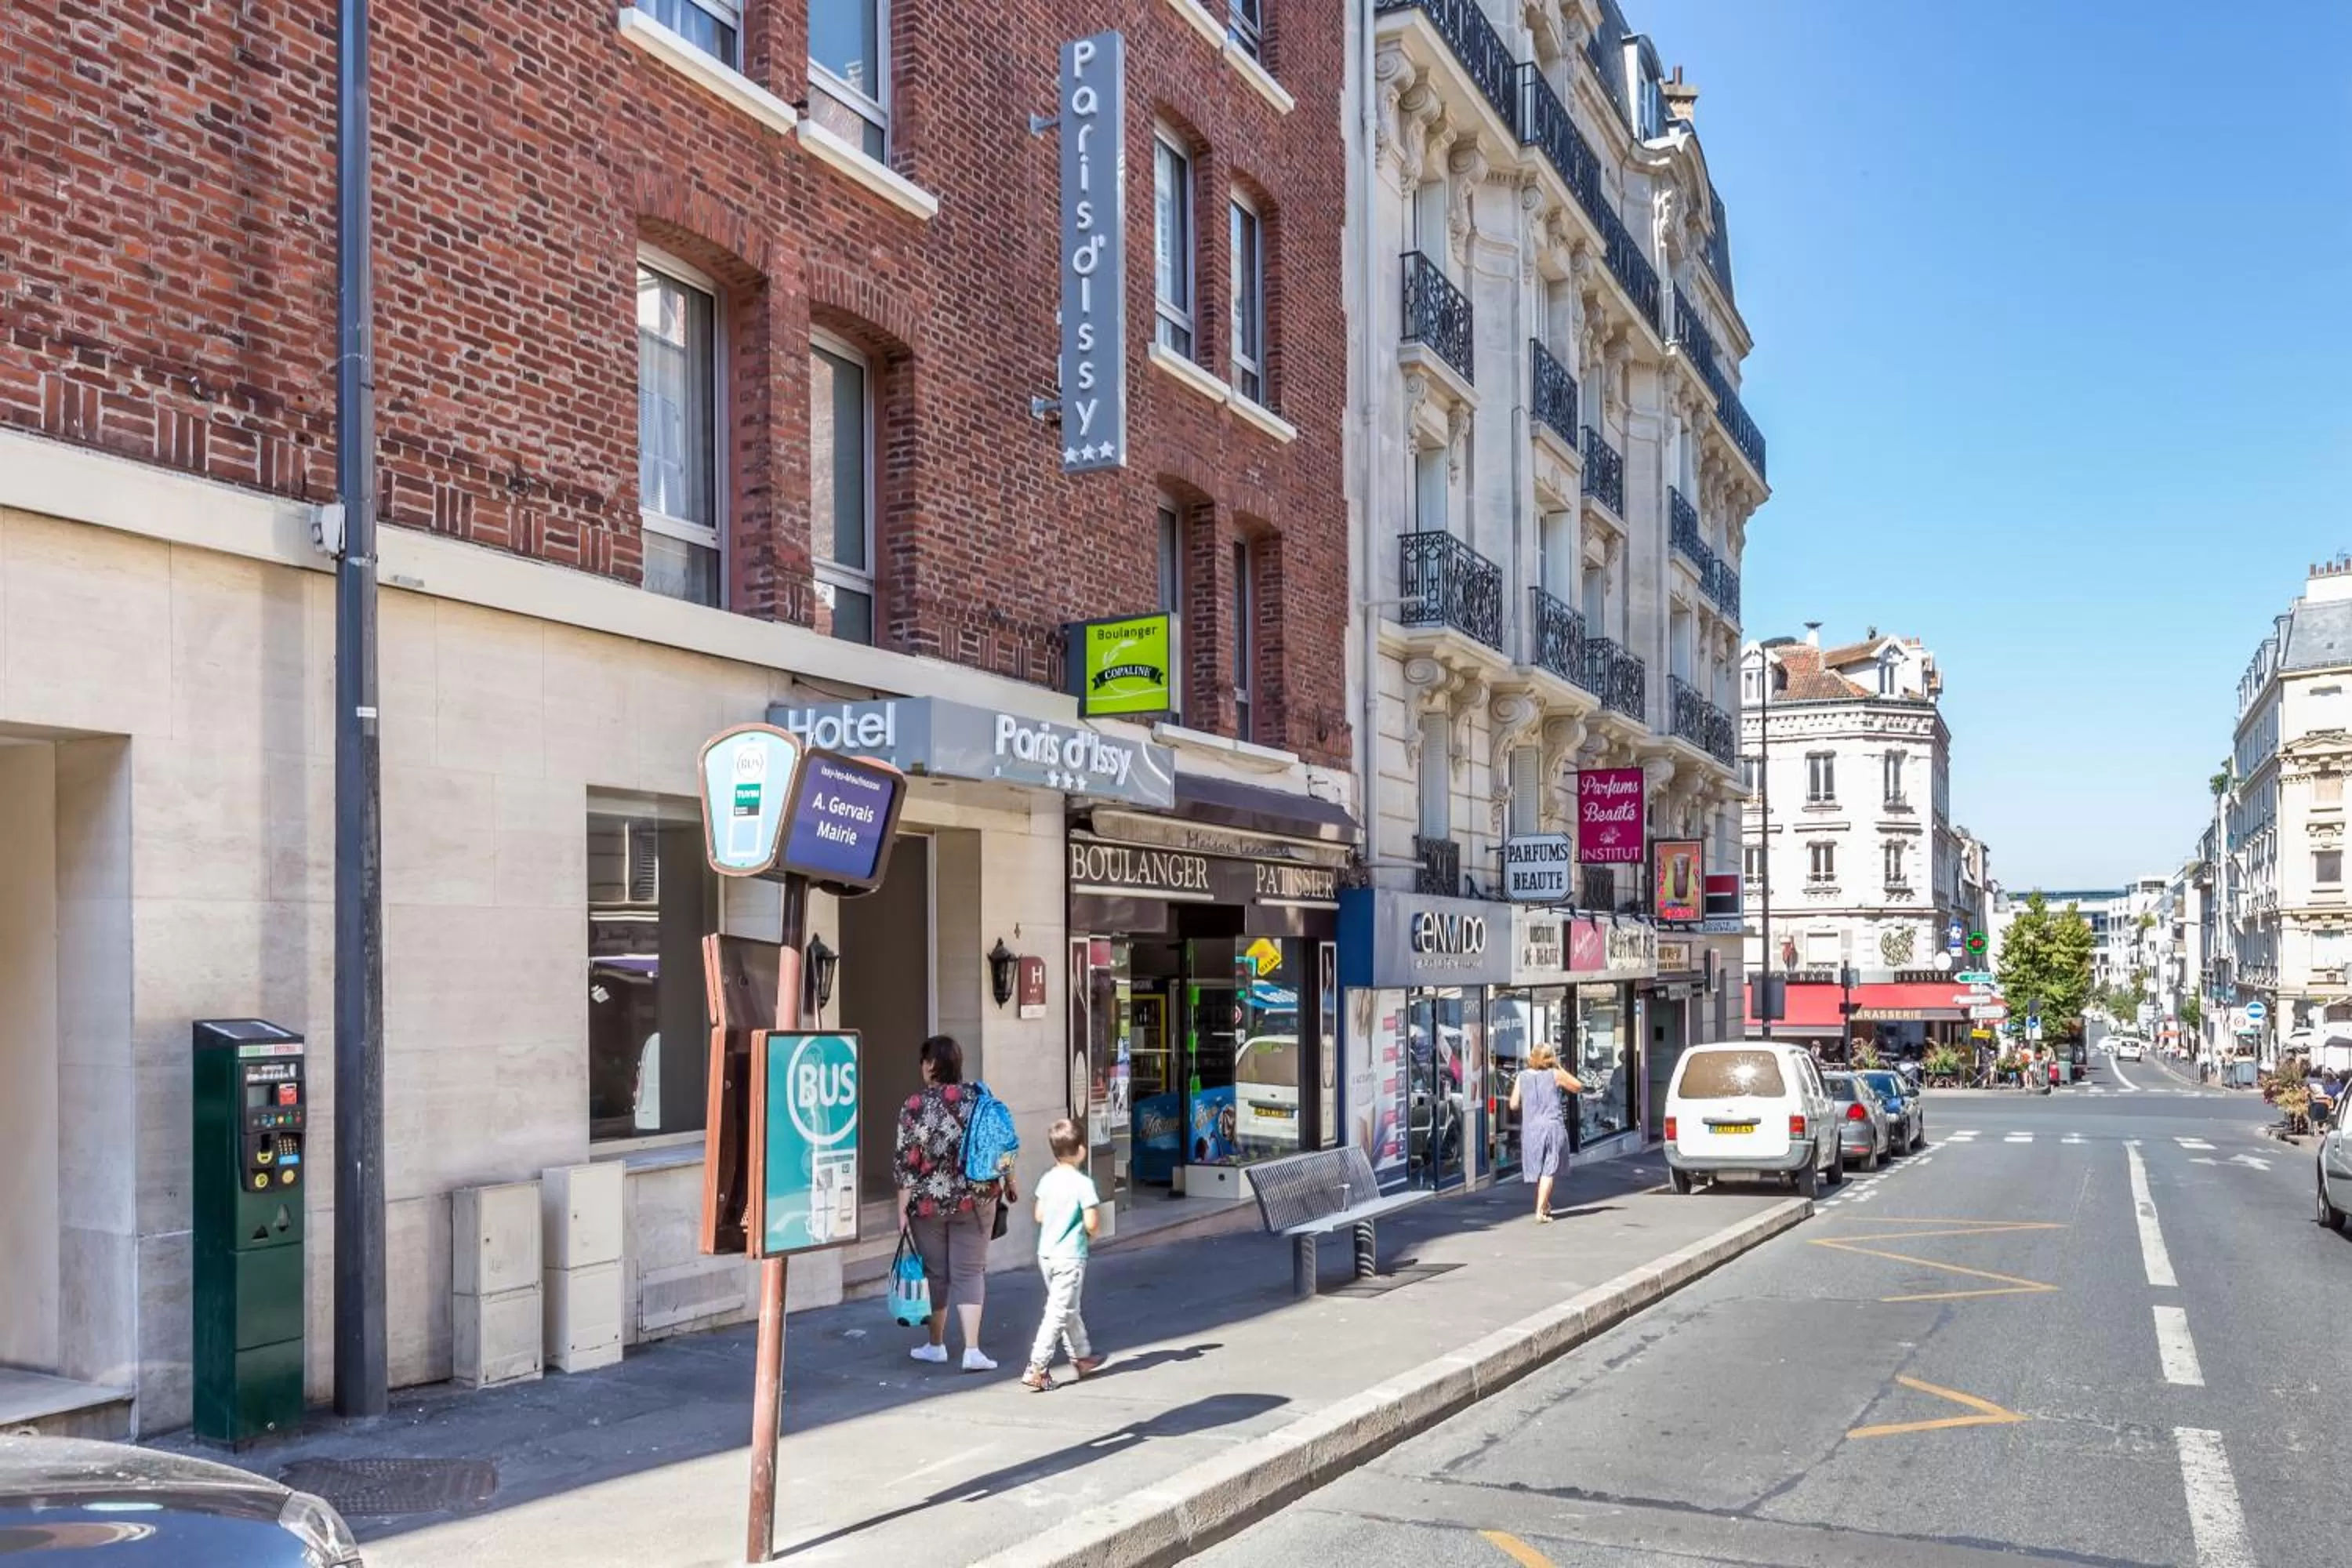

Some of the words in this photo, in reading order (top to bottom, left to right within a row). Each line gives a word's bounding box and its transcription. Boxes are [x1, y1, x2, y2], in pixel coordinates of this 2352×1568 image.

[1097, 626, 1157, 641] Boulanger
[788, 702, 897, 750] Hotel
[994, 714, 1060, 765] Paris
[1063, 730, 1133, 786] d'Issy
[1581, 774, 1639, 800] Parfums
[811, 792, 826, 811] A.
[829, 796, 874, 822] Gervais
[1583, 800, 1637, 822] Beauté
[816, 820, 857, 845] Mairie
[1069, 843, 1209, 888] BOULANGER
[1508, 843, 1569, 863] PARFUMS
[1581, 846, 1641, 860] INSTITUT
[1254, 863, 1335, 899] PATISSIER
[1512, 871, 1563, 891] BEAUTE
[1031, 965, 1043, 985] H
[1896, 971, 1955, 982] BRASSERI
[798, 1063, 856, 1109] BUS
